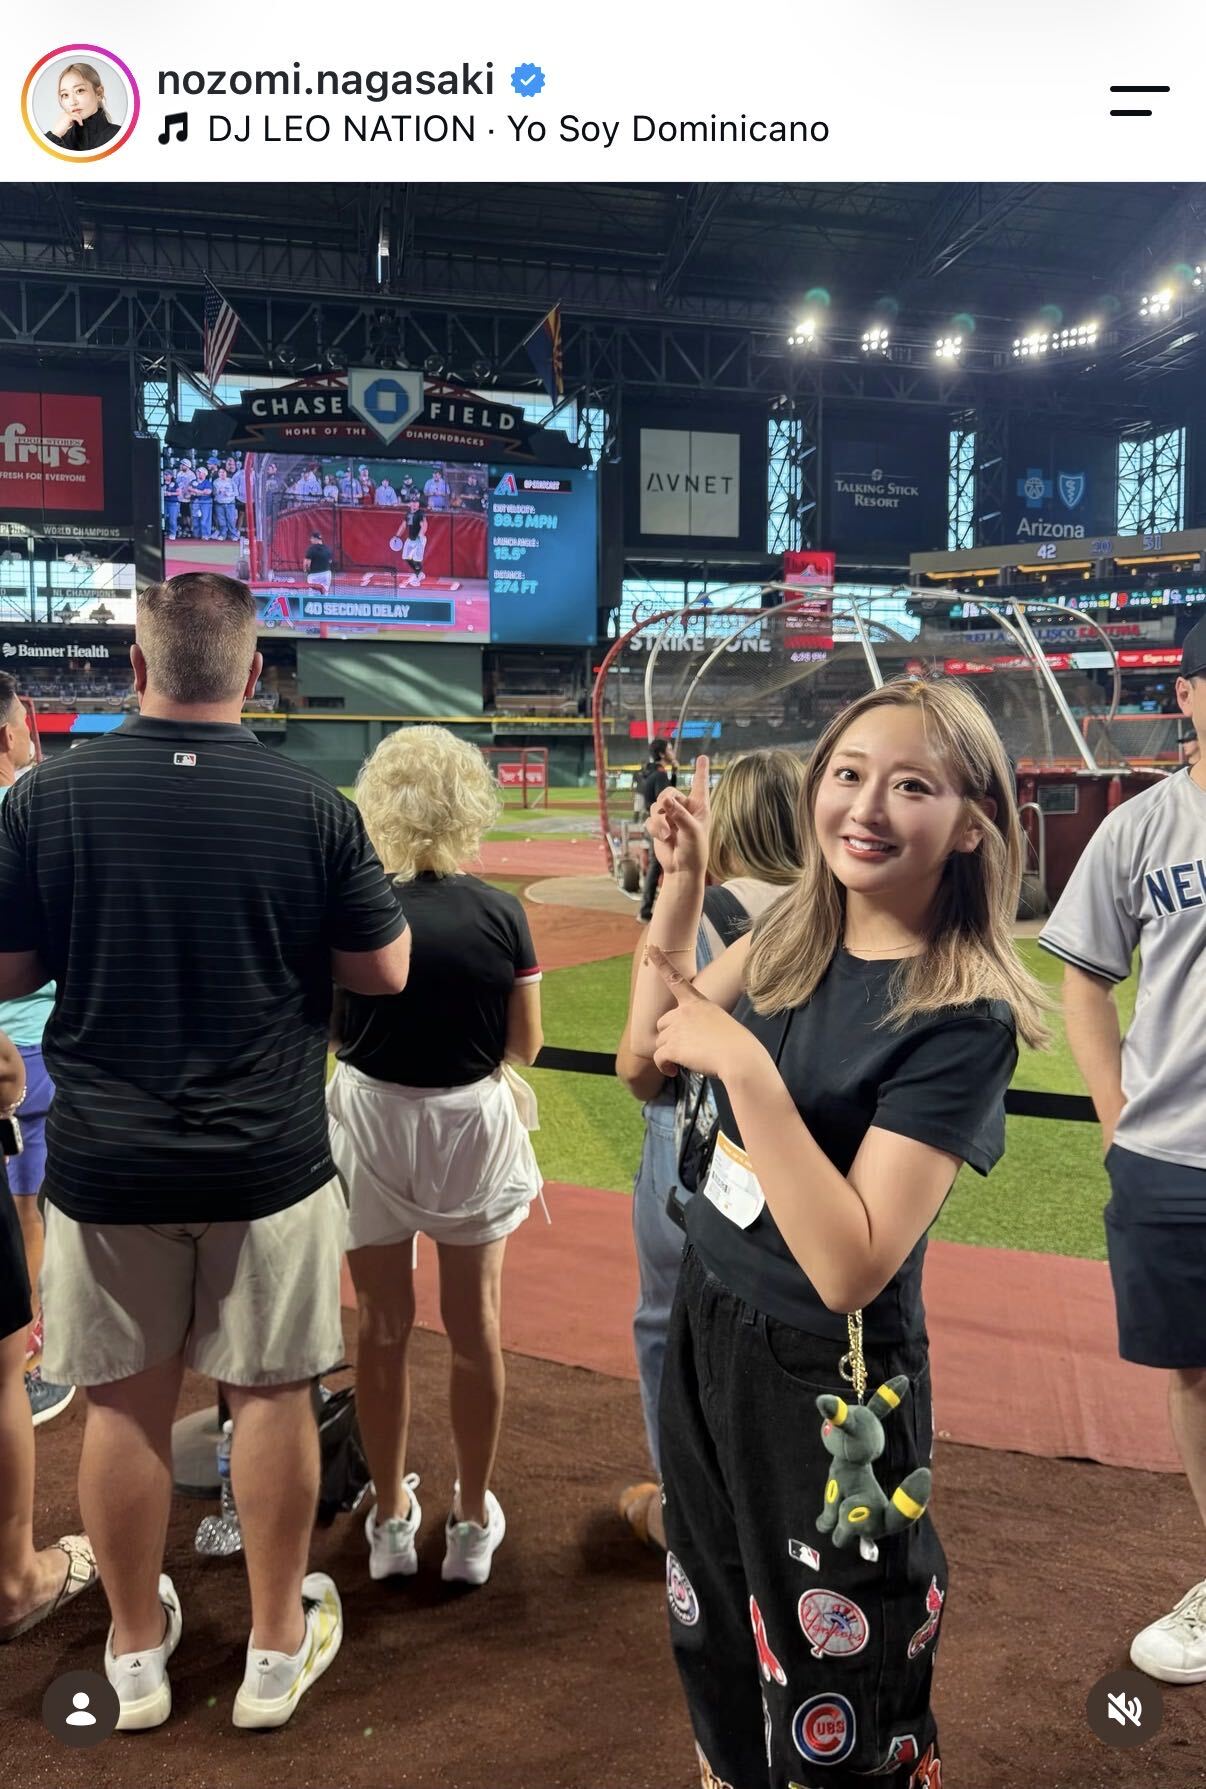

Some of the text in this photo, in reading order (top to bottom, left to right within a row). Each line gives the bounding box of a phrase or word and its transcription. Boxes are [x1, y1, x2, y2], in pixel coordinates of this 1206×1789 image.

[252, 396, 516, 430] CHASE FIELD
[0, 422, 86, 467] fry's
[286, 428, 316, 436] HOME
[346, 427, 366, 436] THE
[406, 430, 485, 447] DIAMONDBACKS
[0, 471, 86, 482] FRESH FOR EVERYONE
[647, 472, 733, 495] AVNET
[855, 494, 900, 508] RESORT
[525, 514, 558, 529] MPH
[1016, 517, 1085, 539] Arizona
[43, 526, 120, 537] WORLD CHAMPIONS
[1142, 534, 1162, 551] 51
[1037, 543, 1057, 559] 42
[53, 589, 116, 599] NL CHAMPIONS
[521, 580, 539, 595] FT
[304, 602, 410, 618] 40 SECOND DELAY
[18, 644, 109, 658] Banner Health
[629, 635, 771, 652] STRIKE ONE
[802, 1703, 846, 1756] CUBS
